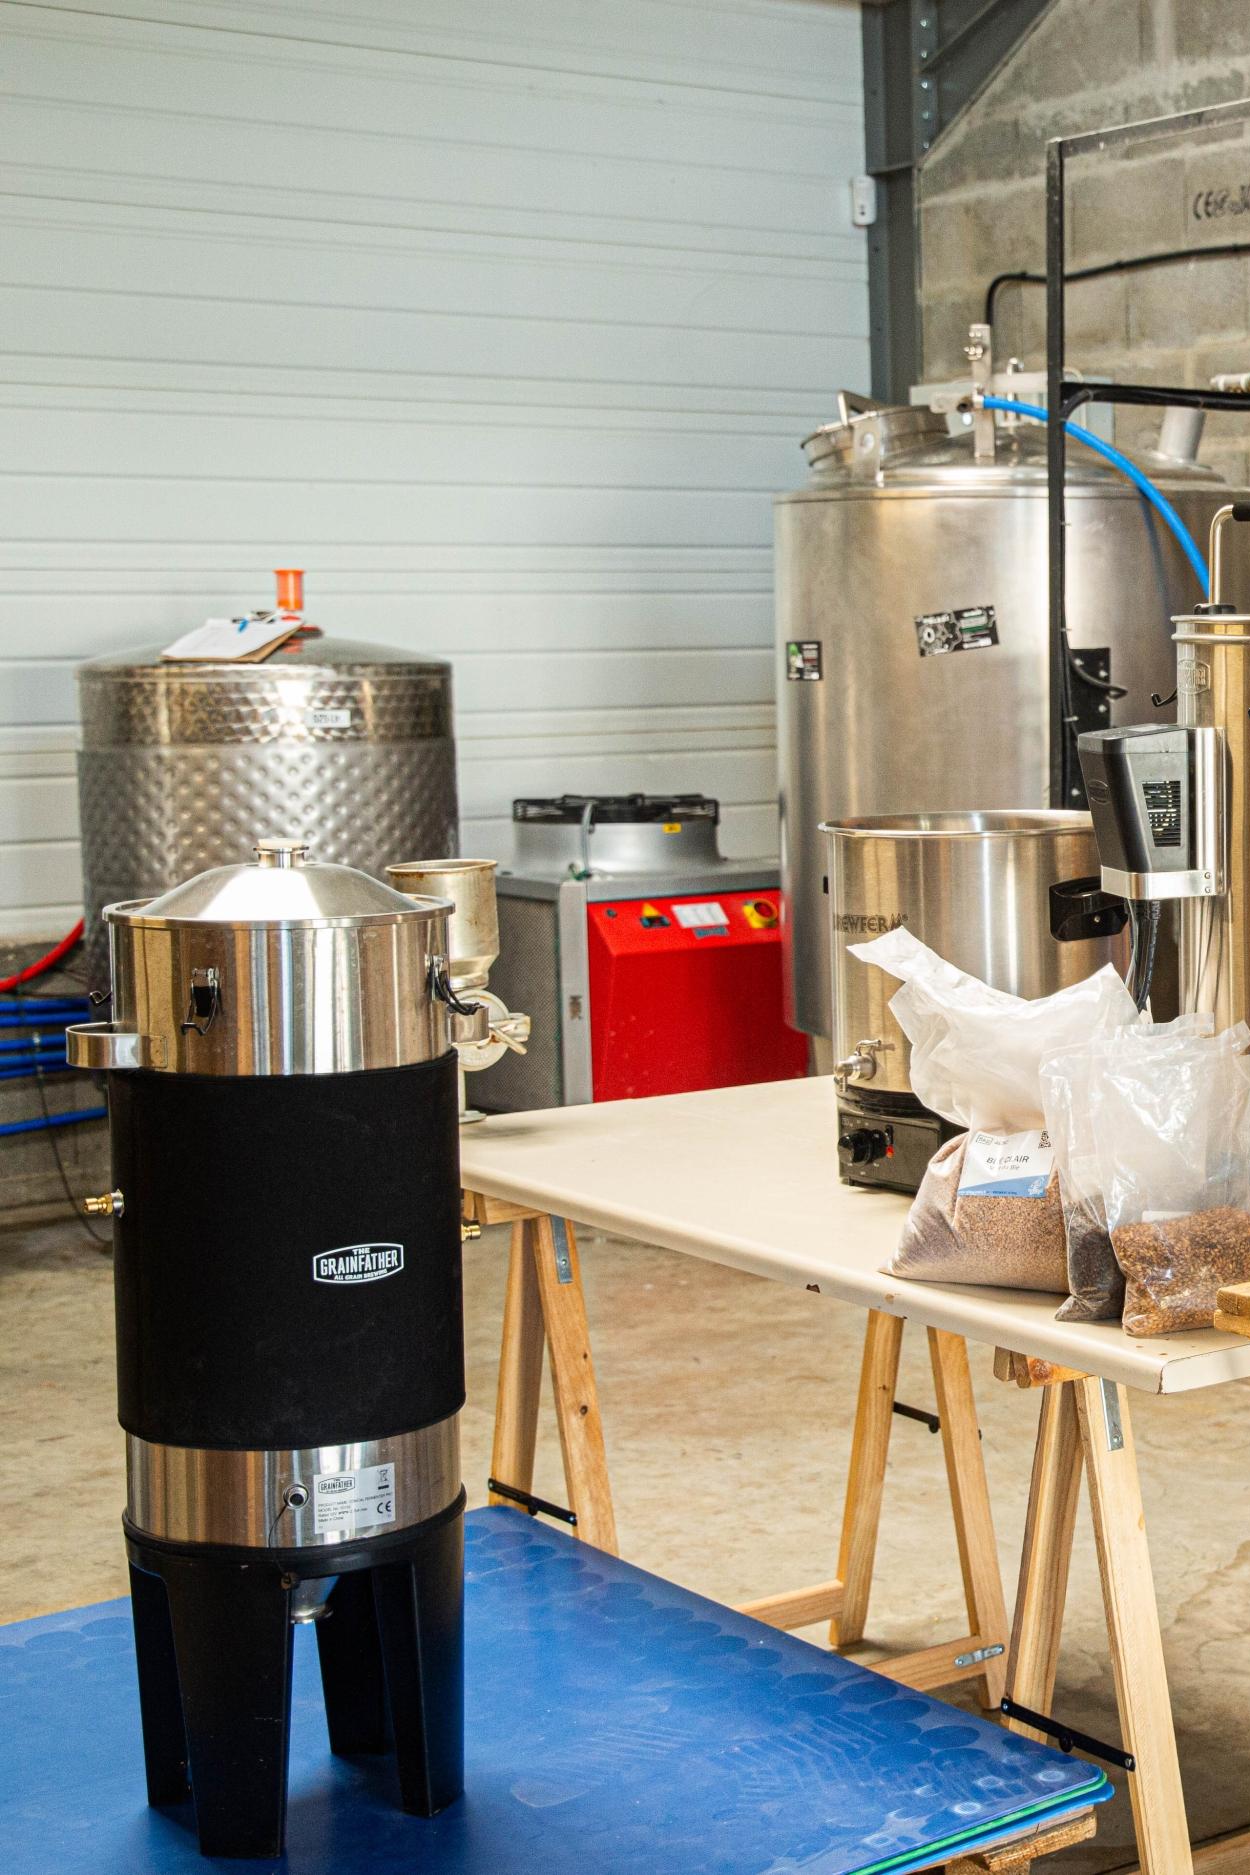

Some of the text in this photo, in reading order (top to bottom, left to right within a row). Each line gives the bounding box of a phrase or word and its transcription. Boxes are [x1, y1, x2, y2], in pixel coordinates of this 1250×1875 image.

[352, 1247, 371, 1255] THE
[320, 1249, 398, 1276] GRAINFATHER
[363, 1268, 388, 1279] BREWING
[320, 1479, 353, 1491] GRAINFATHER
[376, 1500, 392, 1514] CE
